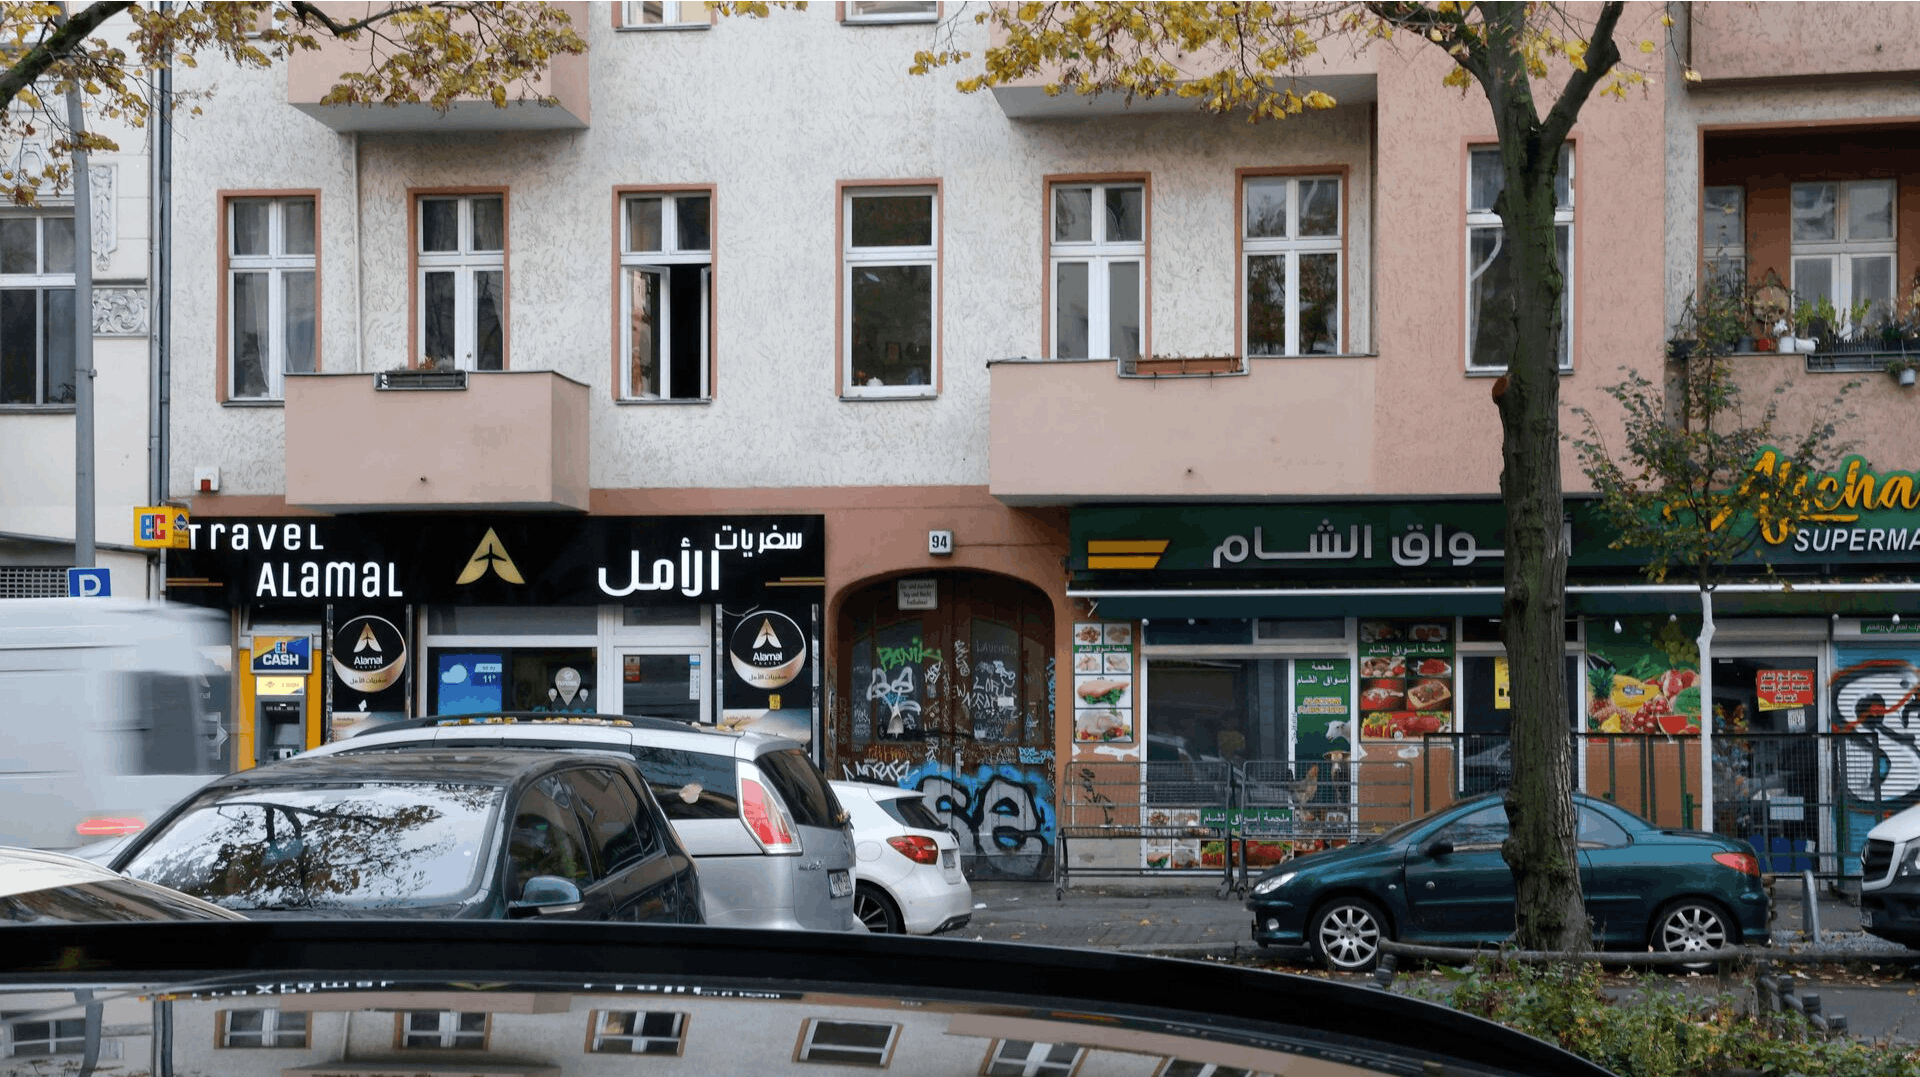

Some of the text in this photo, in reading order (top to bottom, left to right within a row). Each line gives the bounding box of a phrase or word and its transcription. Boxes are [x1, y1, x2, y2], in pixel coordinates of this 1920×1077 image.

[715, 524, 803, 558] سفريات
[932, 535, 948, 549] 94
[598, 537, 721, 597] الأمل
[79, 574, 101, 597] P
[262, 653, 299, 666] CASH
[353, 655, 383, 666] Alamal
[752, 651, 783, 662] Alamal
